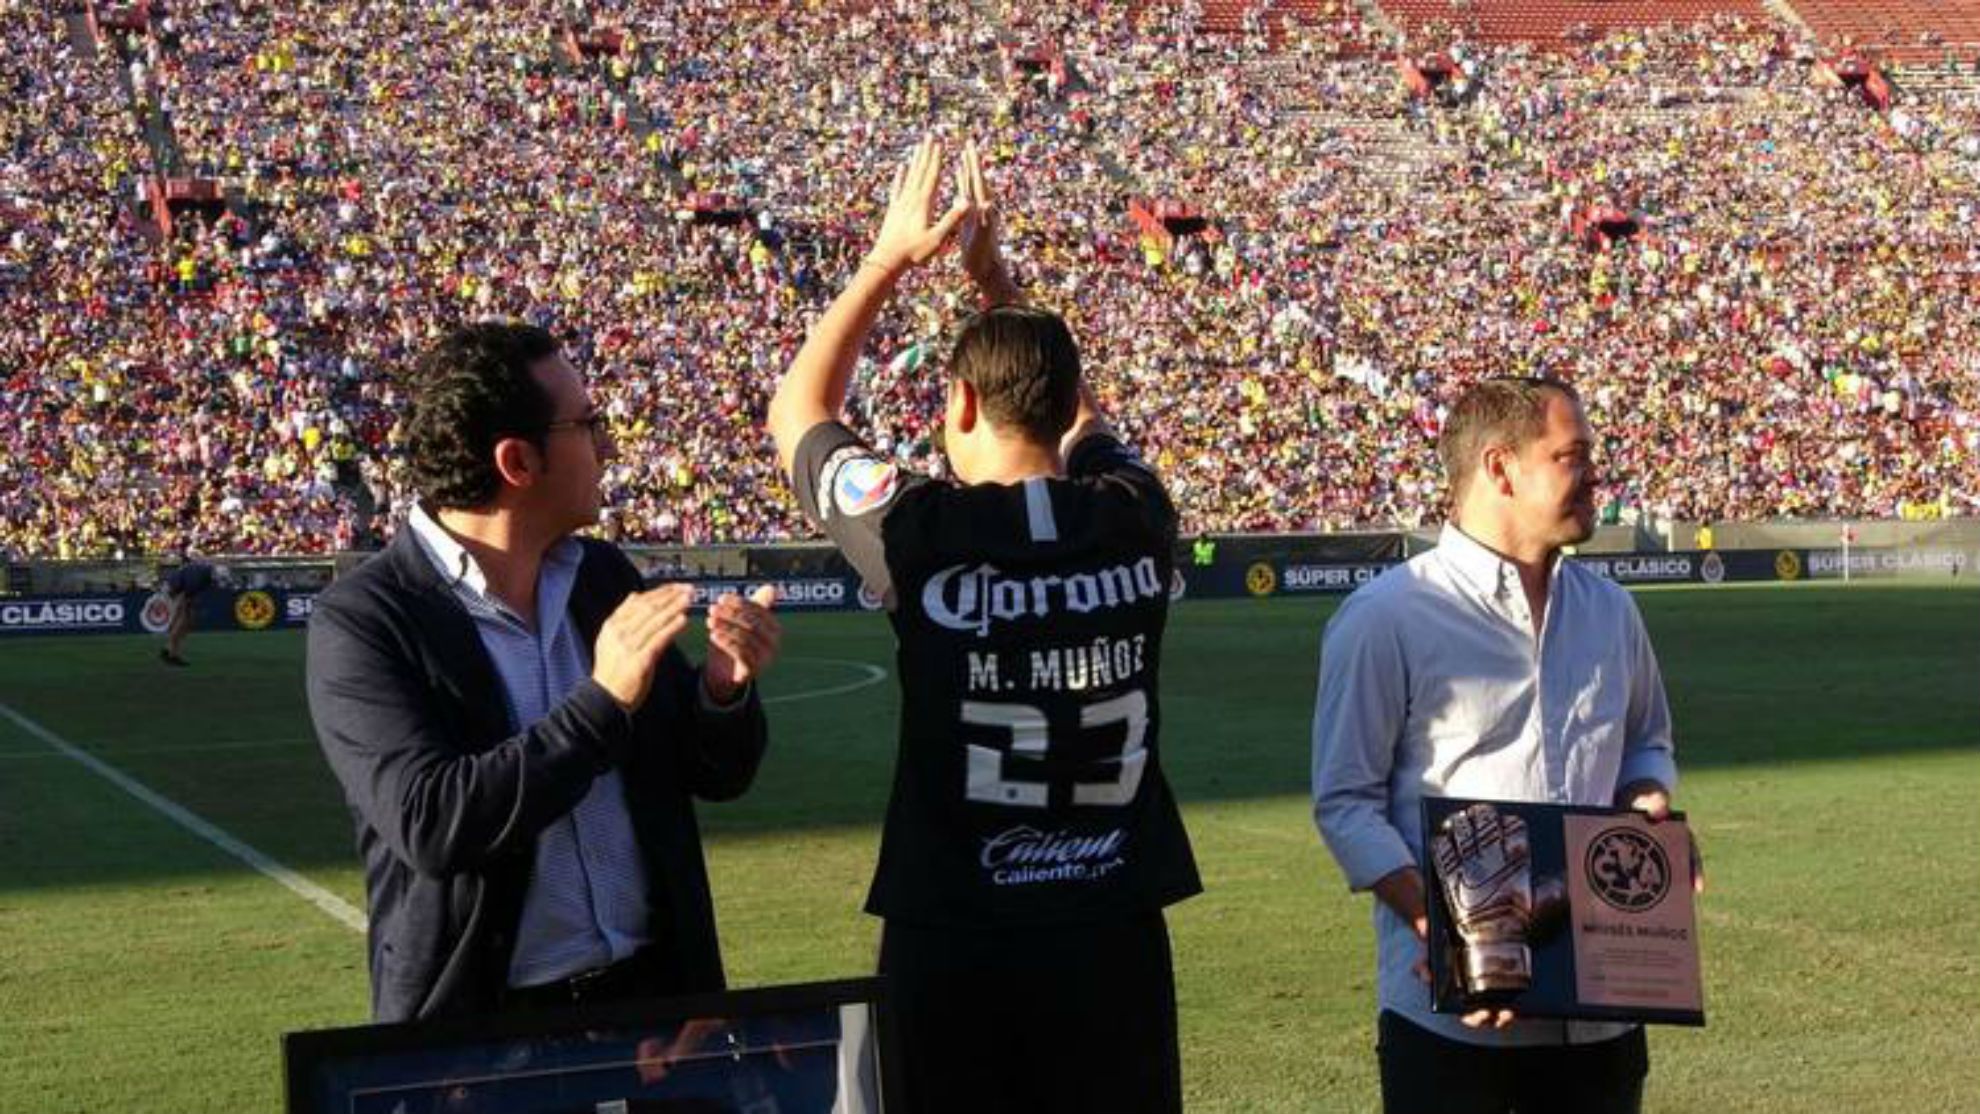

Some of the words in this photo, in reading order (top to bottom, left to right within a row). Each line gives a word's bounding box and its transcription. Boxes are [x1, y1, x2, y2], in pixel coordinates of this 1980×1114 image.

[744, 581, 844, 601] CÁSICO
[1285, 565, 1350, 585] SÚPER
[2, 601, 124, 624] CLÁSICO
[922, 556, 1162, 637] Corona
[967, 651, 1015, 693] M.
[960, 688, 1150, 807] 23
